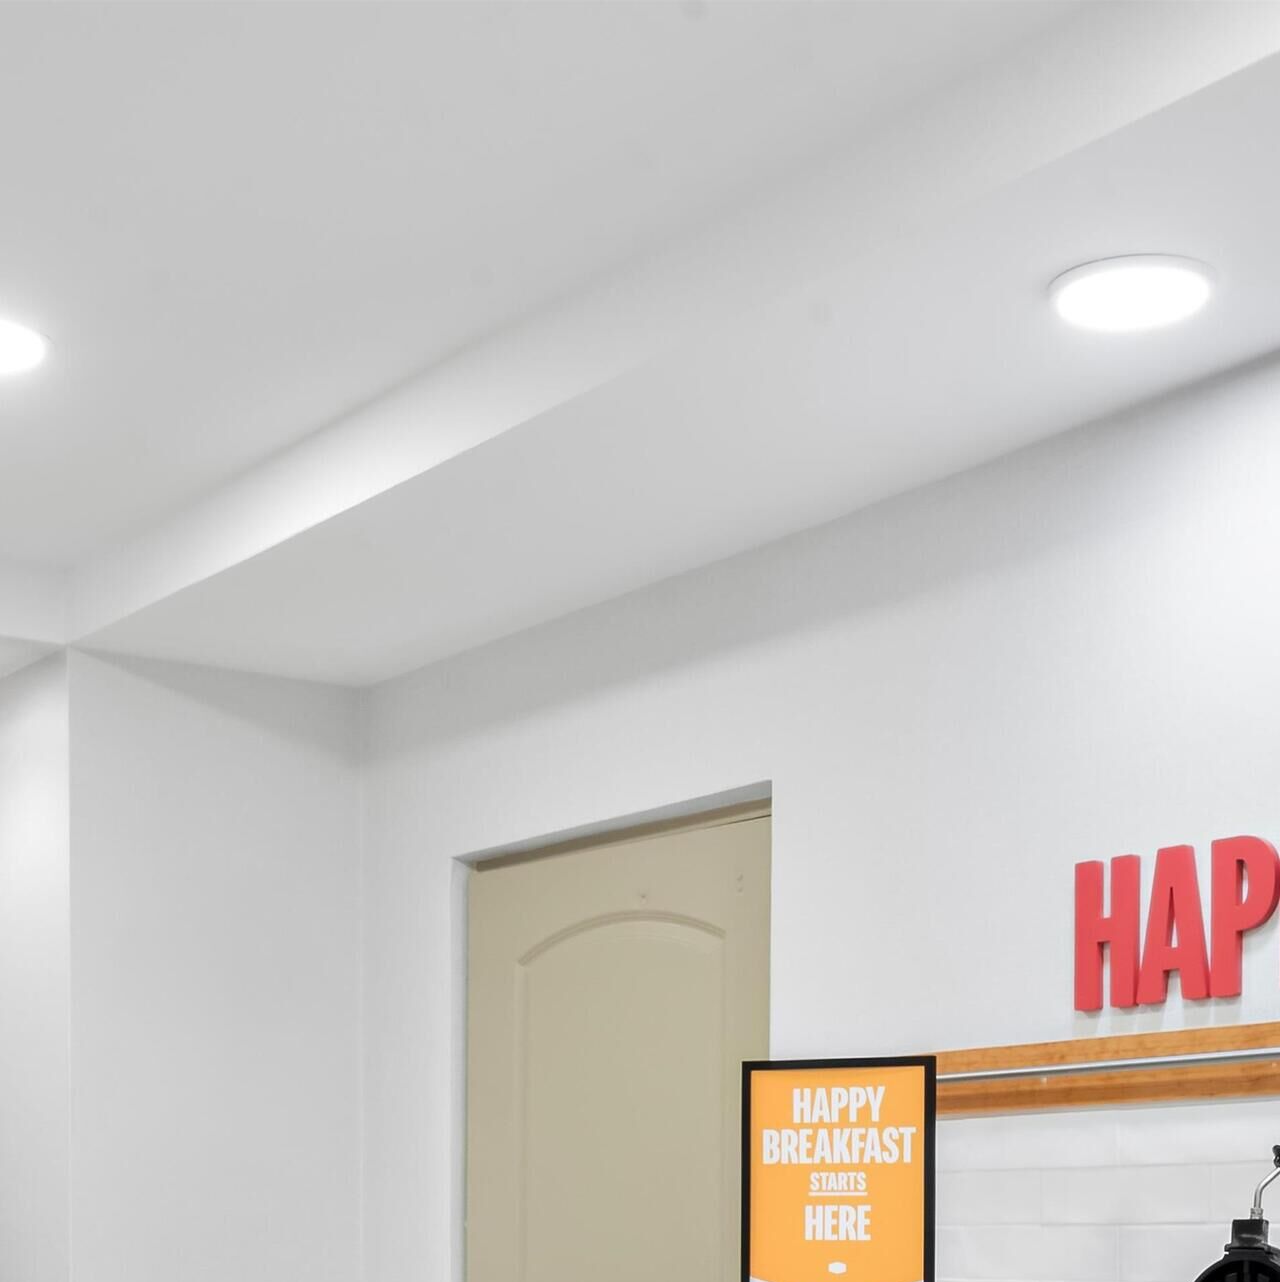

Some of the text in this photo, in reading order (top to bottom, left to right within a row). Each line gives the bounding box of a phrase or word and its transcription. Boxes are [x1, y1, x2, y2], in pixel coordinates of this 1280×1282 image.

[792, 1086, 886, 1124] HAPPY
[762, 1127, 917, 1165] BREAKFAST
[810, 1171, 867, 1192] STARTS
[804, 1204, 872, 1241] HERE
